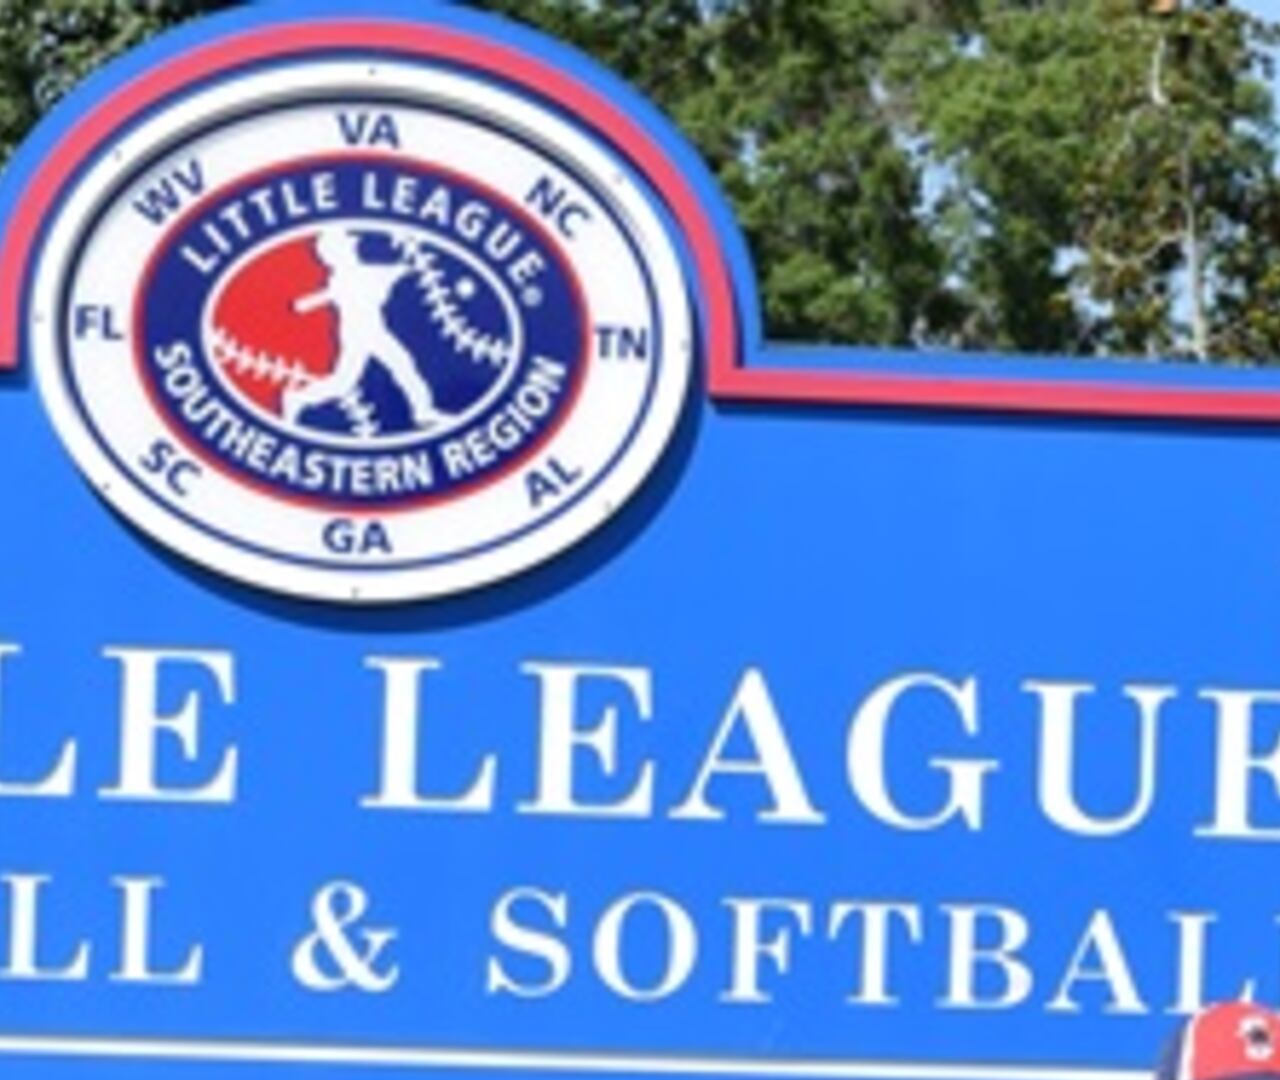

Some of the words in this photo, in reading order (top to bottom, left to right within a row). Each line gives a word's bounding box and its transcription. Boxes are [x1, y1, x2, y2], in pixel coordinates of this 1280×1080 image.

[336, 111, 402, 149] VA
[131, 157, 209, 228] WV
[521, 174, 595, 242] NC
[180, 171, 339, 275] LITTLE
[360, 171, 545, 291] LEAGUE
[74, 306, 124, 341] FL
[594, 325, 648, 362] TN
[152, 340, 434, 496] SOUTHEASTERN
[440, 353, 568, 480] REGION
[138, 438, 203, 497] SC
[522, 452, 584, 508] AL
[321, 517, 393, 556] GA
[290, 881, 400, 993] &
